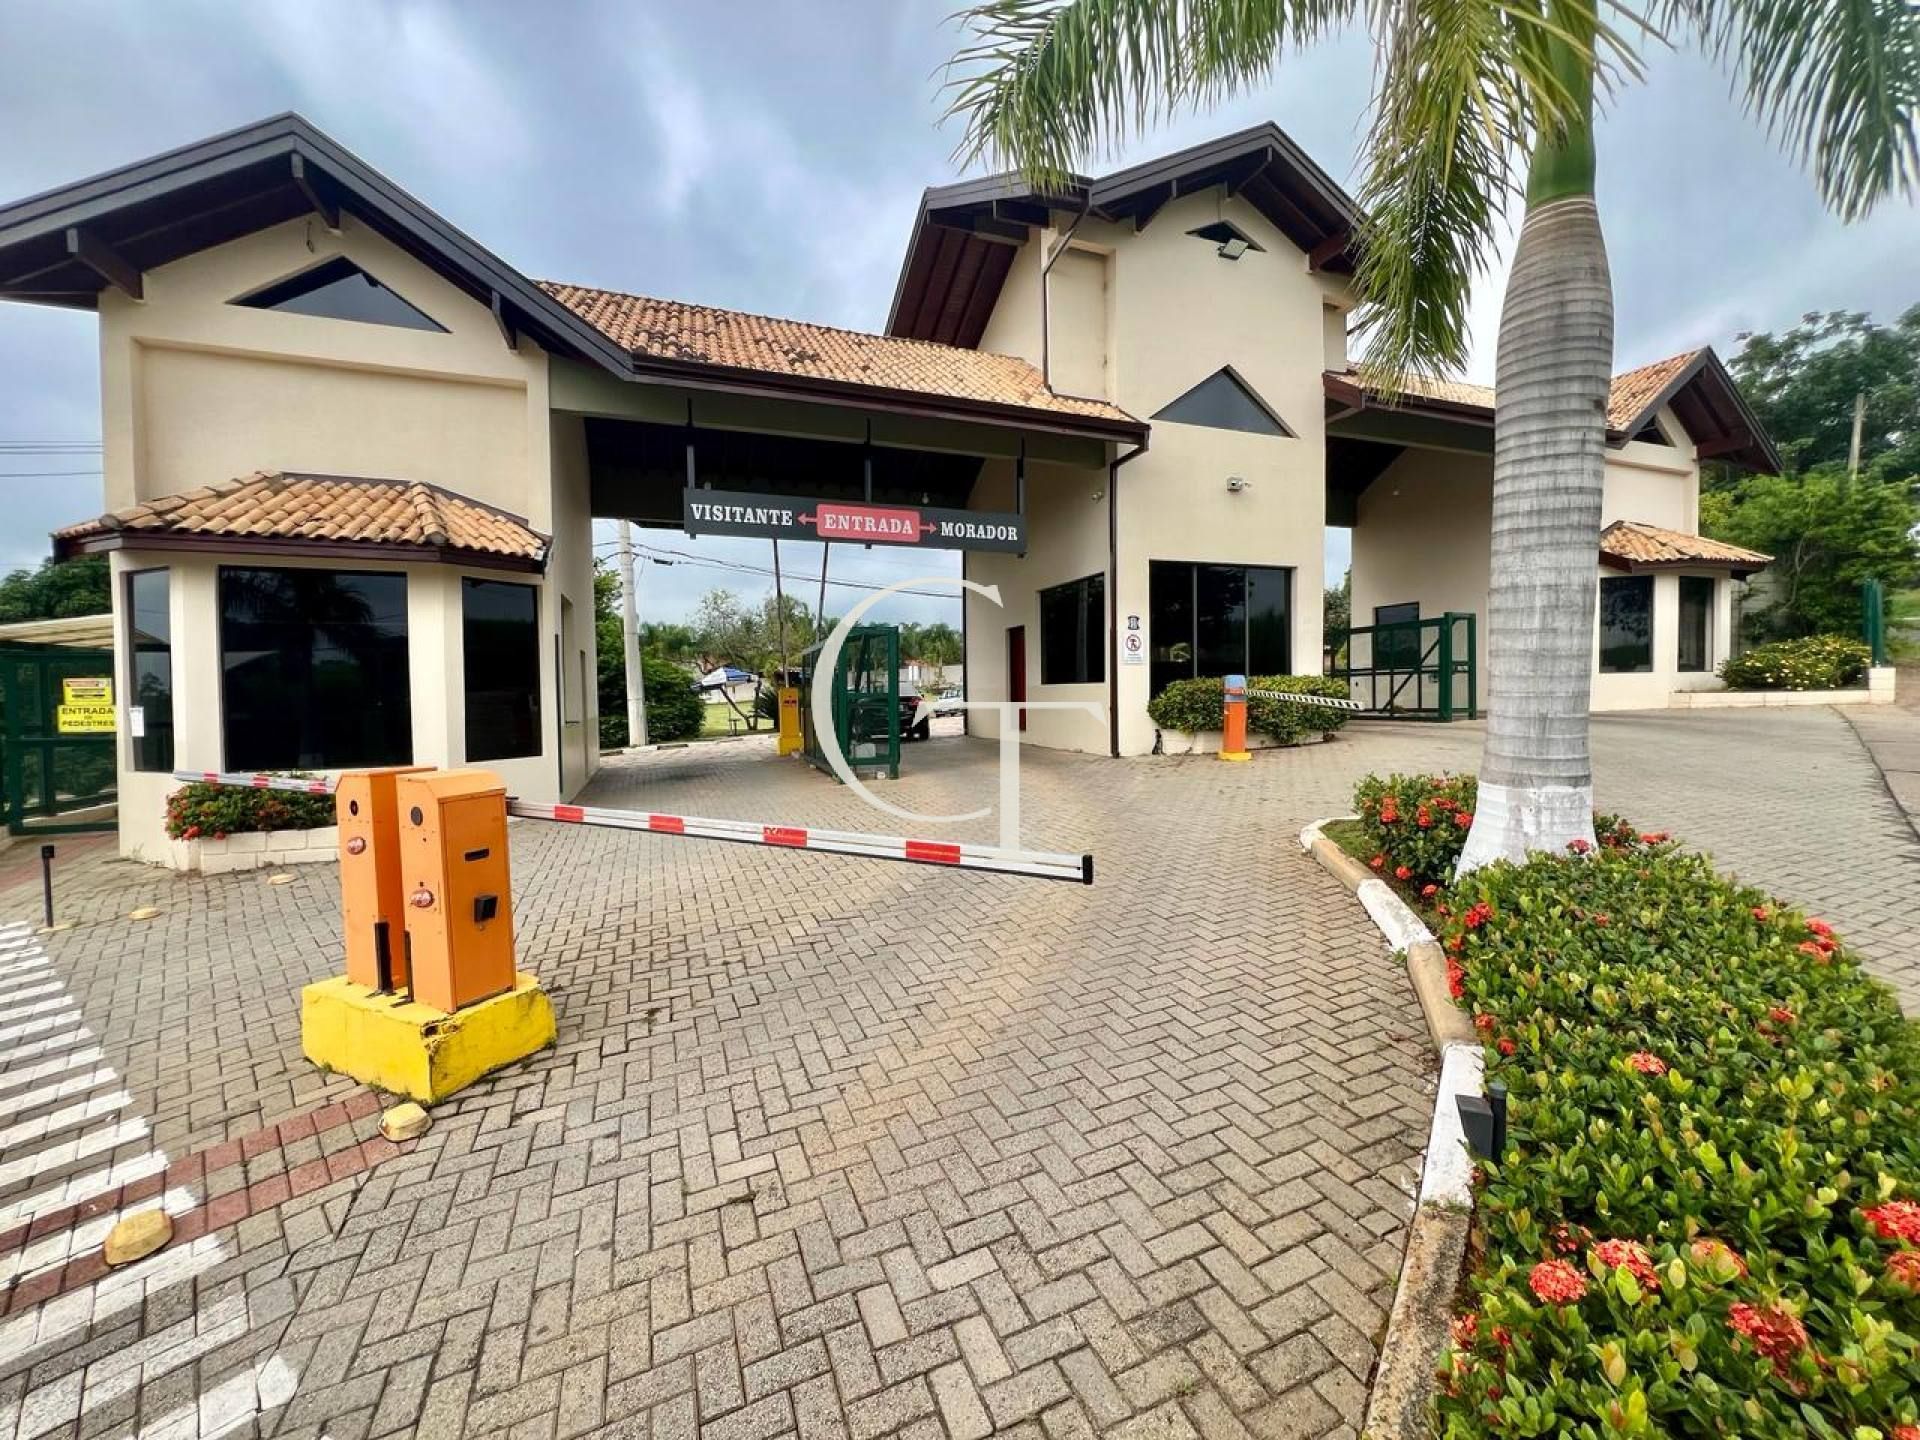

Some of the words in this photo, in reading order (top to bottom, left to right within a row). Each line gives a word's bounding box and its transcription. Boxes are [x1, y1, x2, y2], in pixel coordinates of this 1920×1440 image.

[690, 503, 793, 526] VISITANTE
[823, 514, 913, 535] ENTRADA
[940, 521, 1018, 541] MORADOR
[62, 707, 114, 715] ENTRADA
